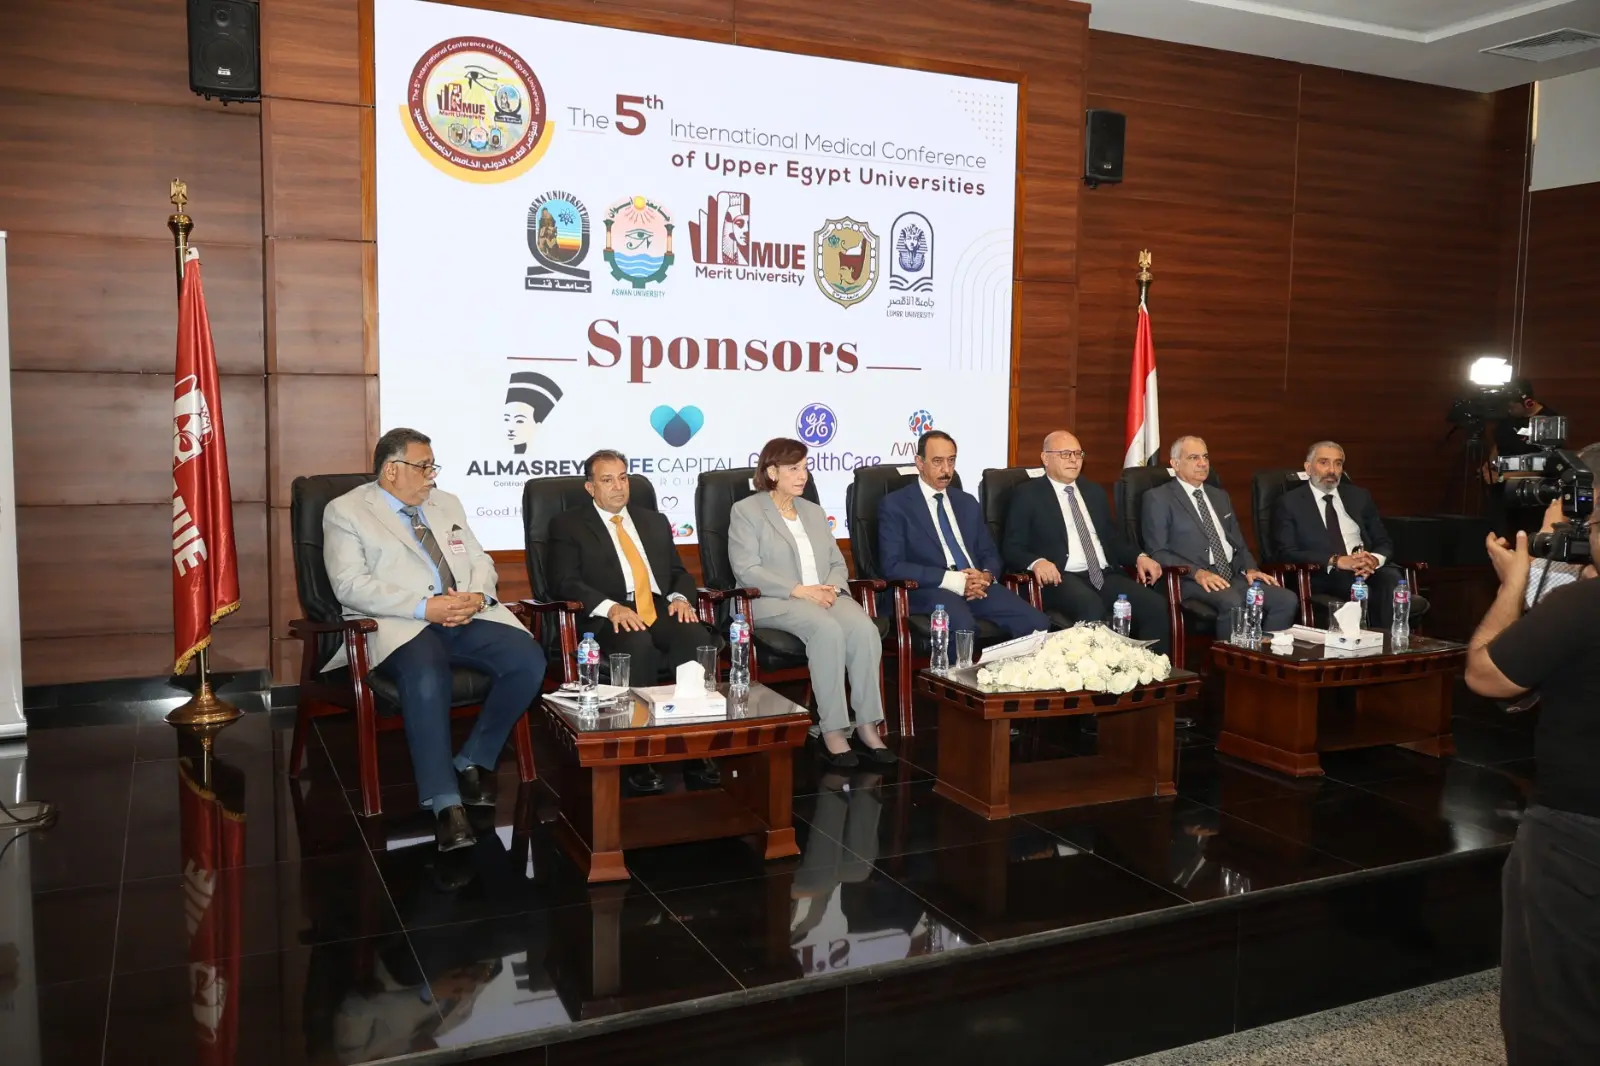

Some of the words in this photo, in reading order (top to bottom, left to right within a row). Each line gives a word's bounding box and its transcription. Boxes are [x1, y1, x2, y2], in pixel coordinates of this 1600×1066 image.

[447, 41, 485, 51] Conference
[486, 42, 495, 50] of
[494, 45, 515, 62] Upper
[513, 58, 529, 78] Egypt
[439, 109, 455, 118] Merit
[455, 110, 486, 121] University
[462, 102, 486, 115] MUE
[567, 106, 609, 129] The
[615, 94, 664, 136] 5th
[670, 118, 798, 149] International
[805, 132, 876, 158] Medical
[881, 142, 987, 169] Conference
[671, 151, 696, 168] of
[705, 152, 778, 177] Upper
[787, 160, 851, 186] Egypt
[859, 167, 986, 196] Universities
[751, 241, 806, 270] MUE
[695, 265, 733, 280] Merit
[735, 268, 805, 287] University
[611, 288, 633, 297] ASWAN
[633, 289, 666, 299] UNIVERSITY
[586, 318, 859, 384] Sponsors
[466, 460, 586, 476] ALMASREY
[629, 458, 654, 473] FE
[805, 451, 881, 472] althCare
[476, 506, 510, 517] Good
[514, 507, 523, 517] H
